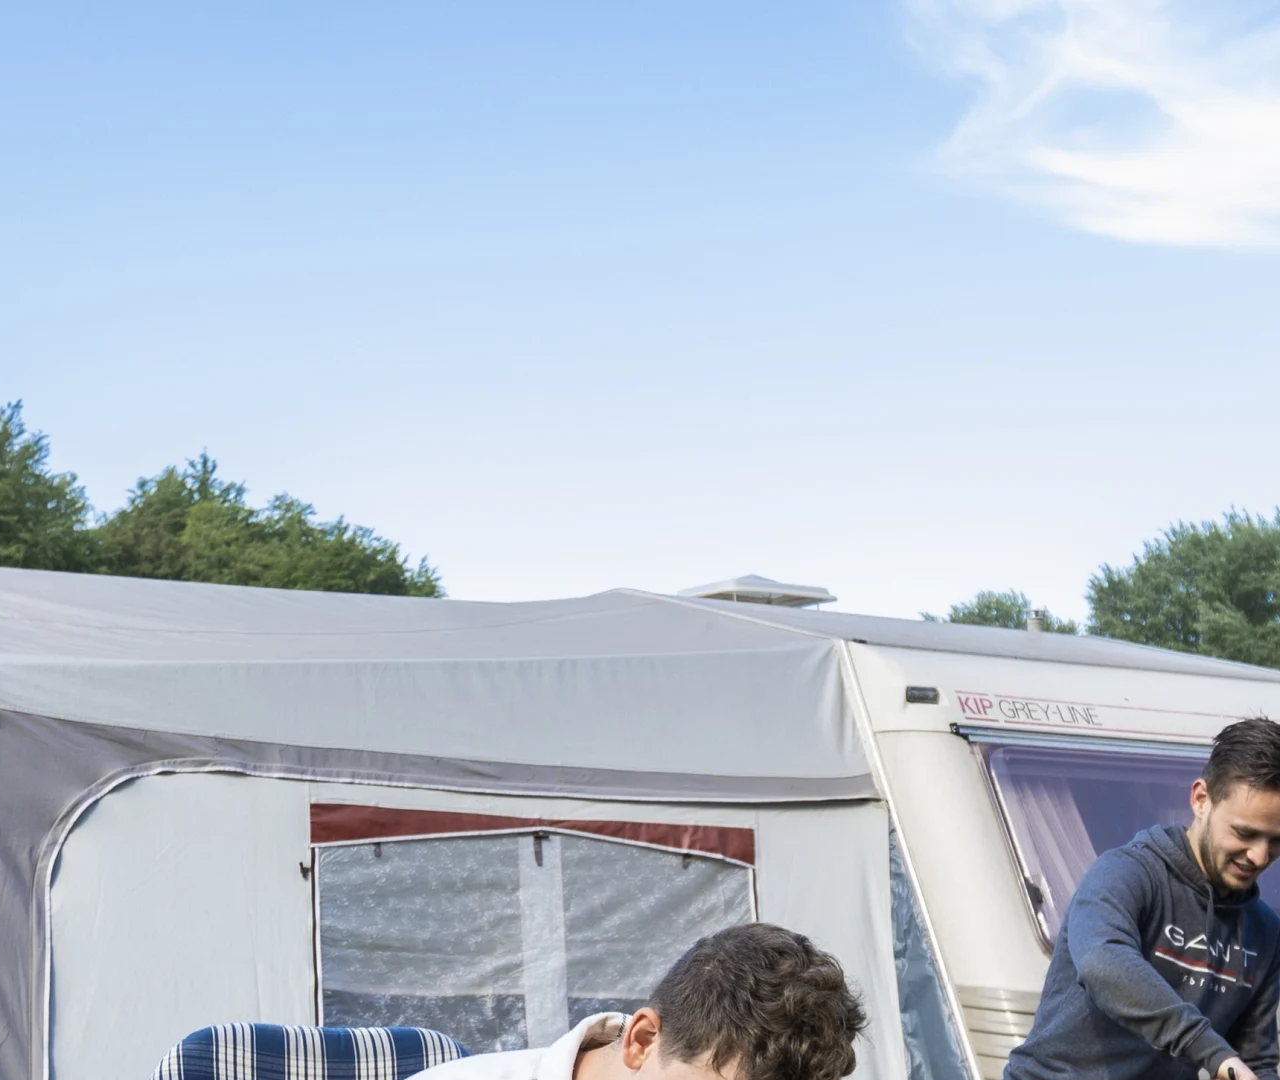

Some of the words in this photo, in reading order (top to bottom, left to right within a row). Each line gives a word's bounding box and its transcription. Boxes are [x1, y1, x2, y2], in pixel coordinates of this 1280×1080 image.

[957, 695, 994, 716] KIP
[998, 699, 1103, 726] GREY-LINE
[1164, 924, 1258, 968] GANT
